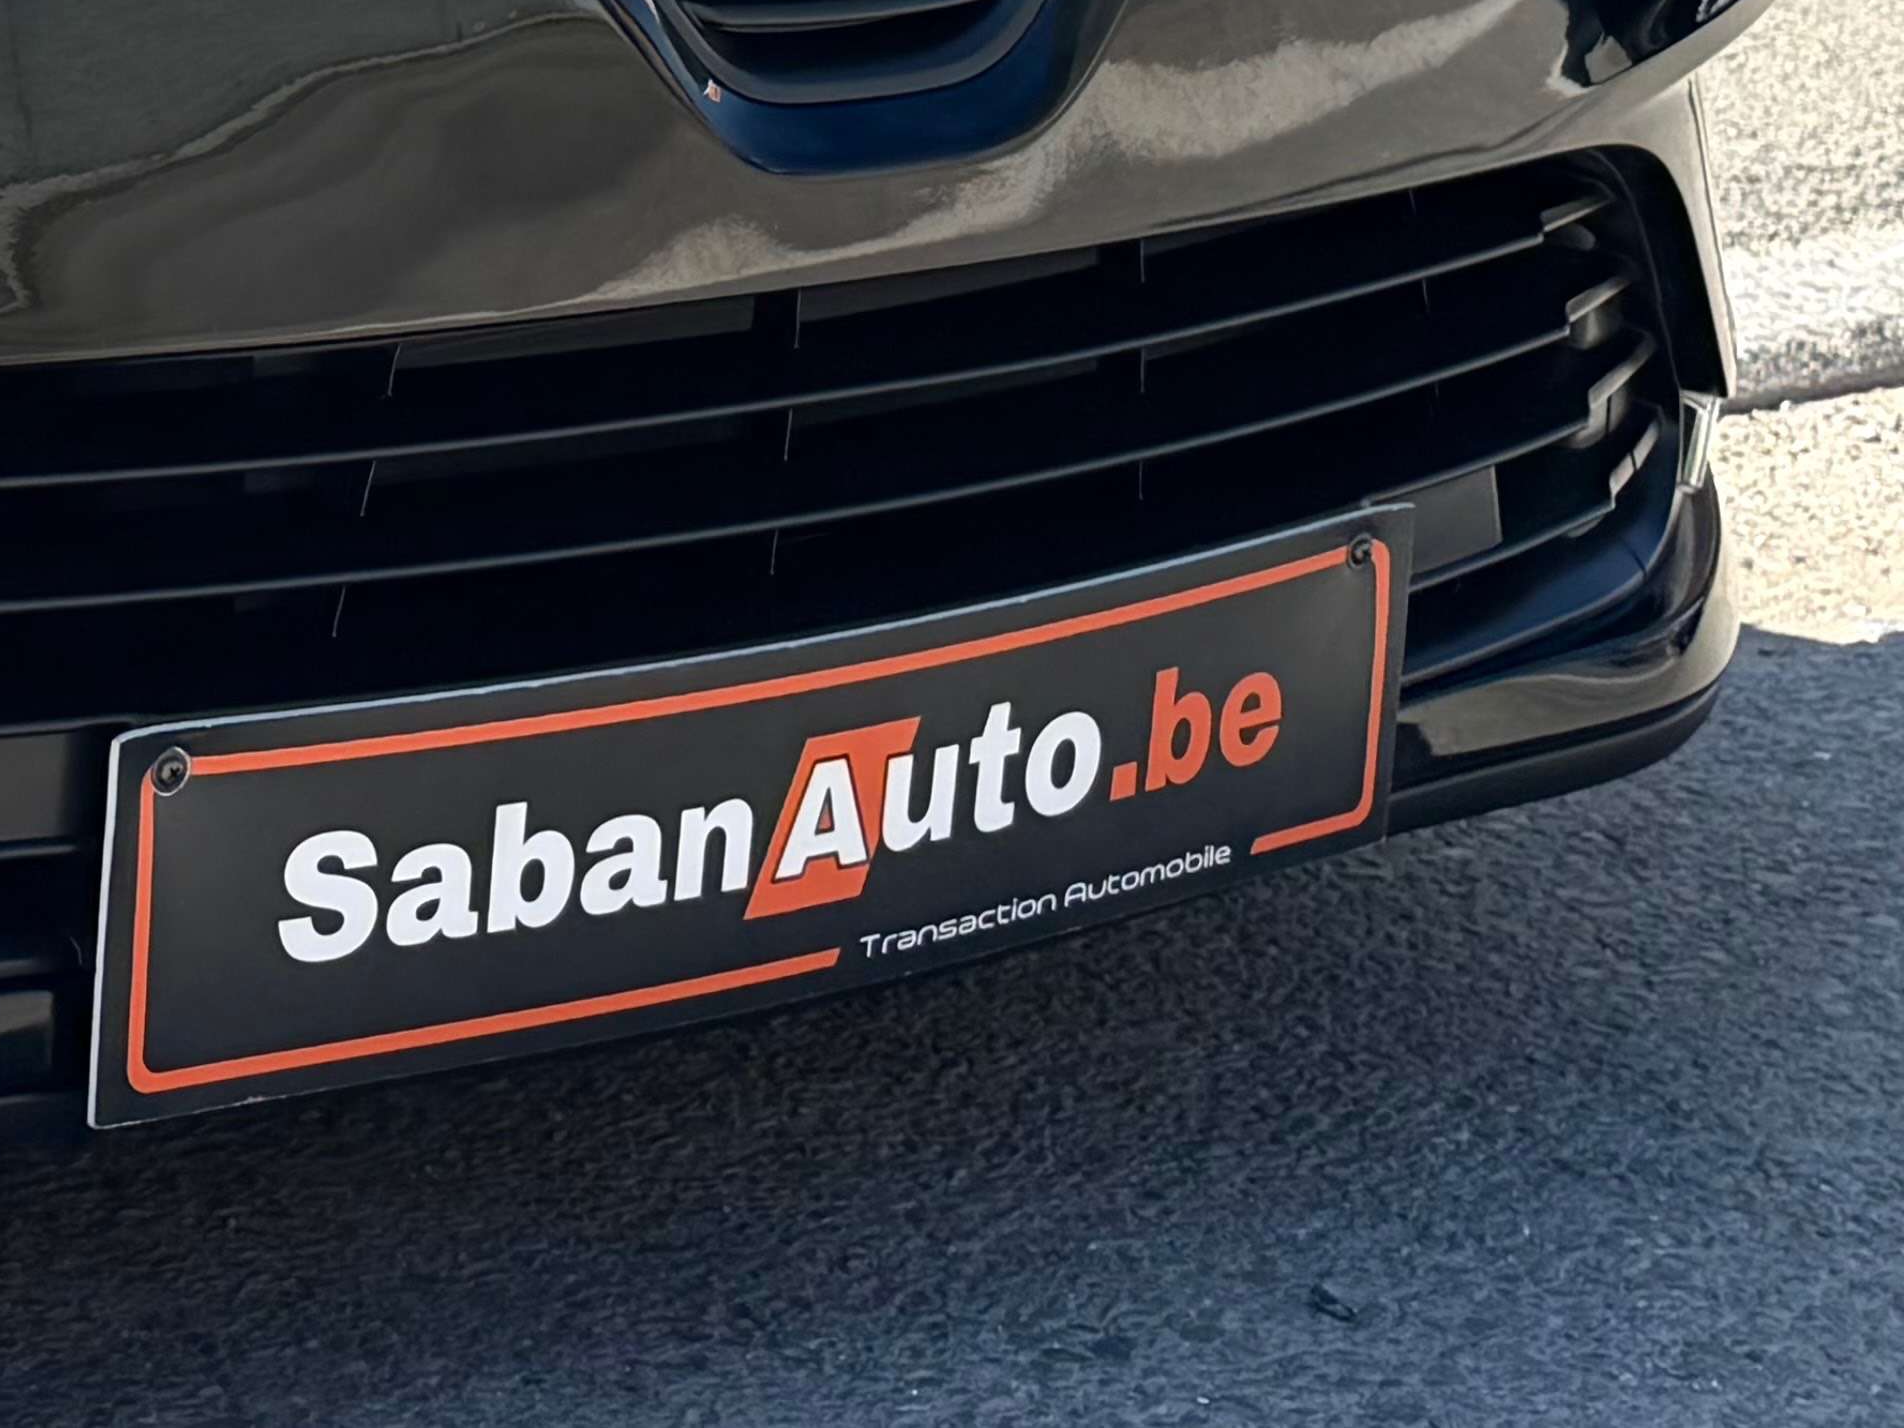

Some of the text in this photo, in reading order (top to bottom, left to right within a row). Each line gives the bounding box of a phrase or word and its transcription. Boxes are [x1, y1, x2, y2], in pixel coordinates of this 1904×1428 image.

[278, 668, 1284, 962] SabanAuto.be
[860, 845, 1232, 959] Transaction Automobile
